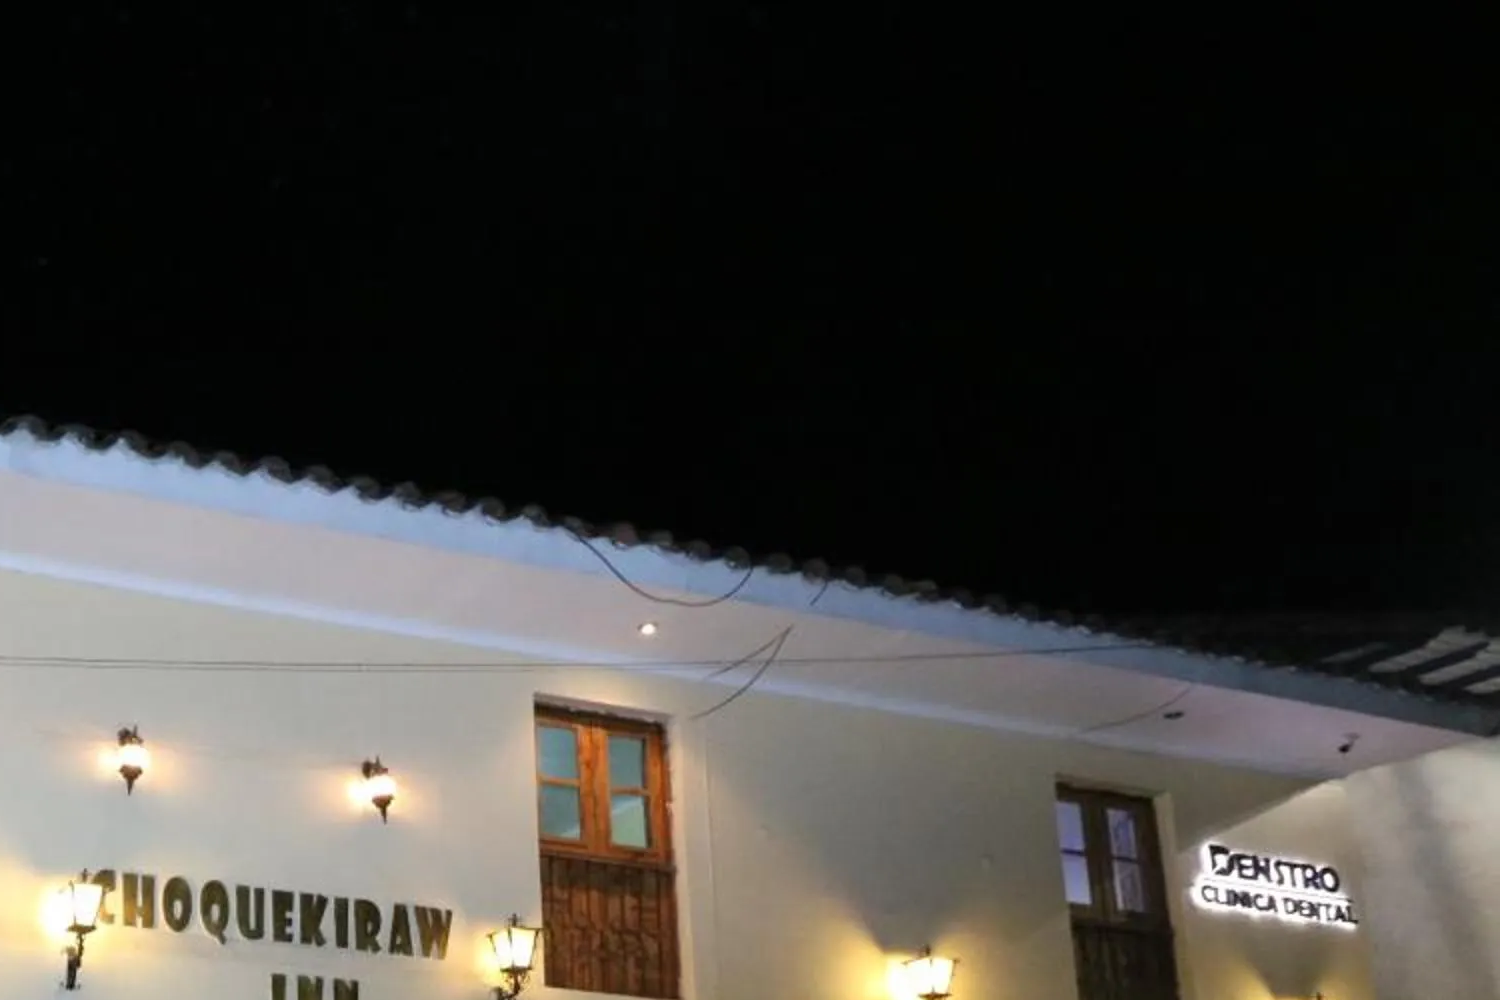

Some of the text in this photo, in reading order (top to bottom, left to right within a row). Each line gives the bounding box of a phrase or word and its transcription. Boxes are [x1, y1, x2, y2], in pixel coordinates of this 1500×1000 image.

[1207, 844, 1341, 893] DENSTRO
[92, 868, 453, 960] CHOQUEKIRAW
[1200, 885, 1359, 925] CLINICA DENTAL
